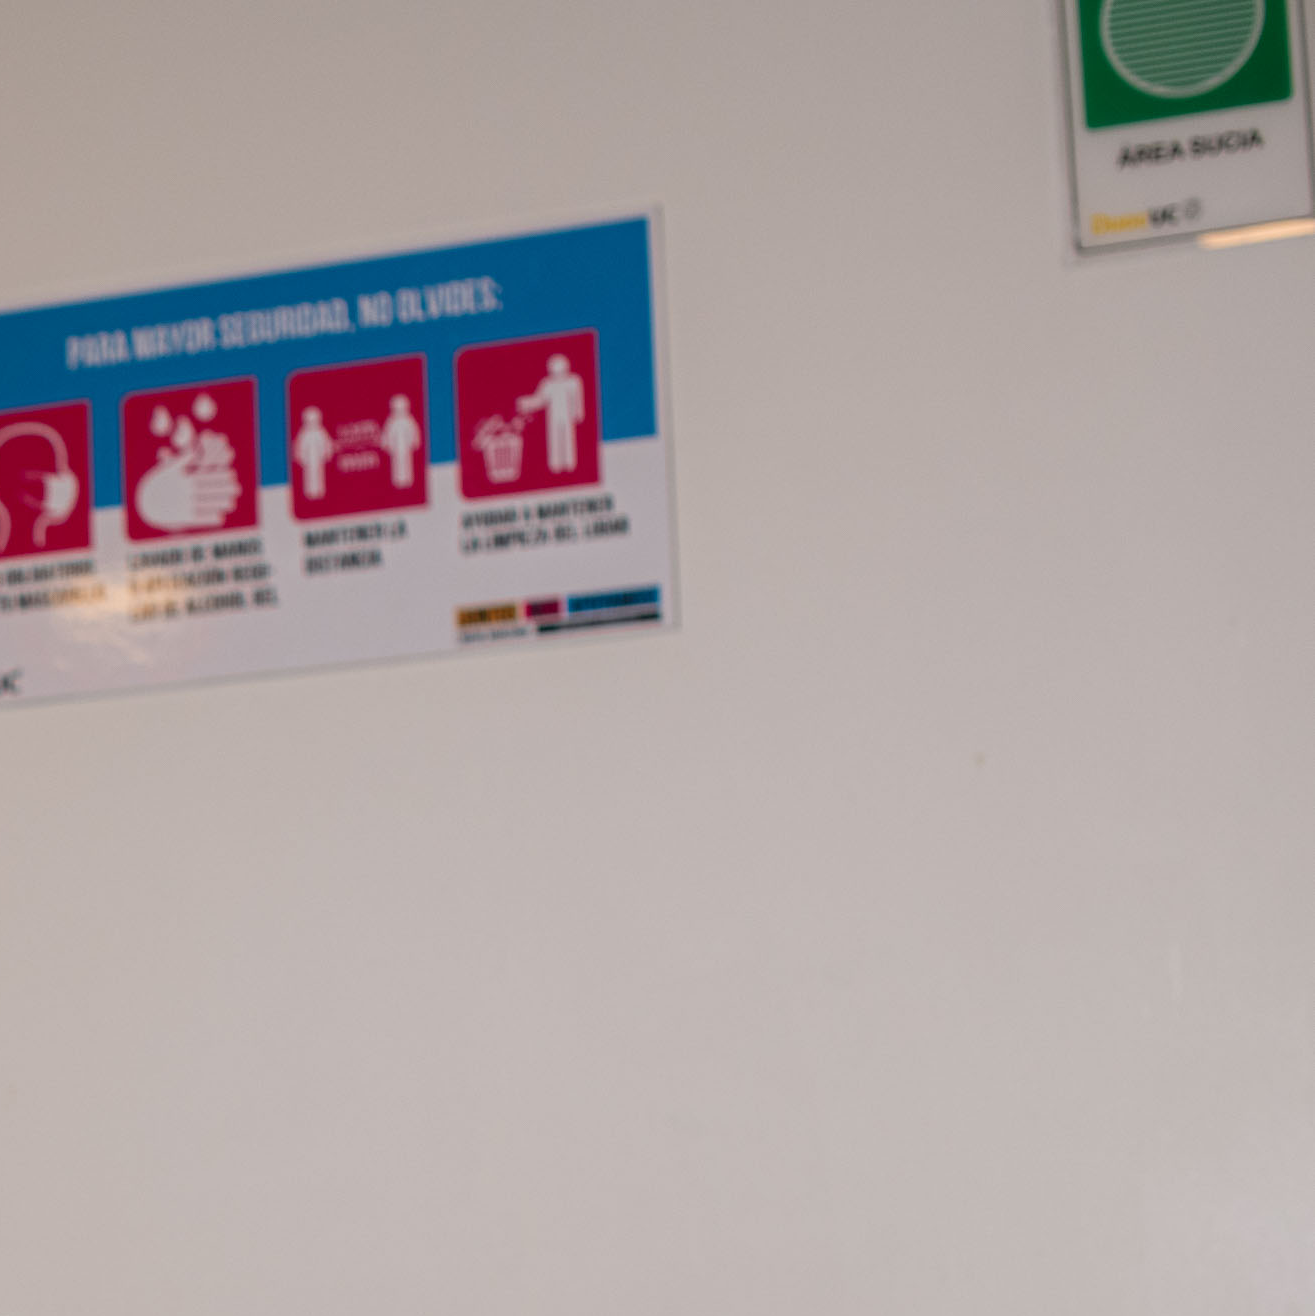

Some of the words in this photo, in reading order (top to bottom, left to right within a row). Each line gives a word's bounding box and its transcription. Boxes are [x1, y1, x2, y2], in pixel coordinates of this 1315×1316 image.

[66, 328, 129, 370] PARA
[132, 315, 216, 362] MAYOR
[357, 290, 393, 329] NO
